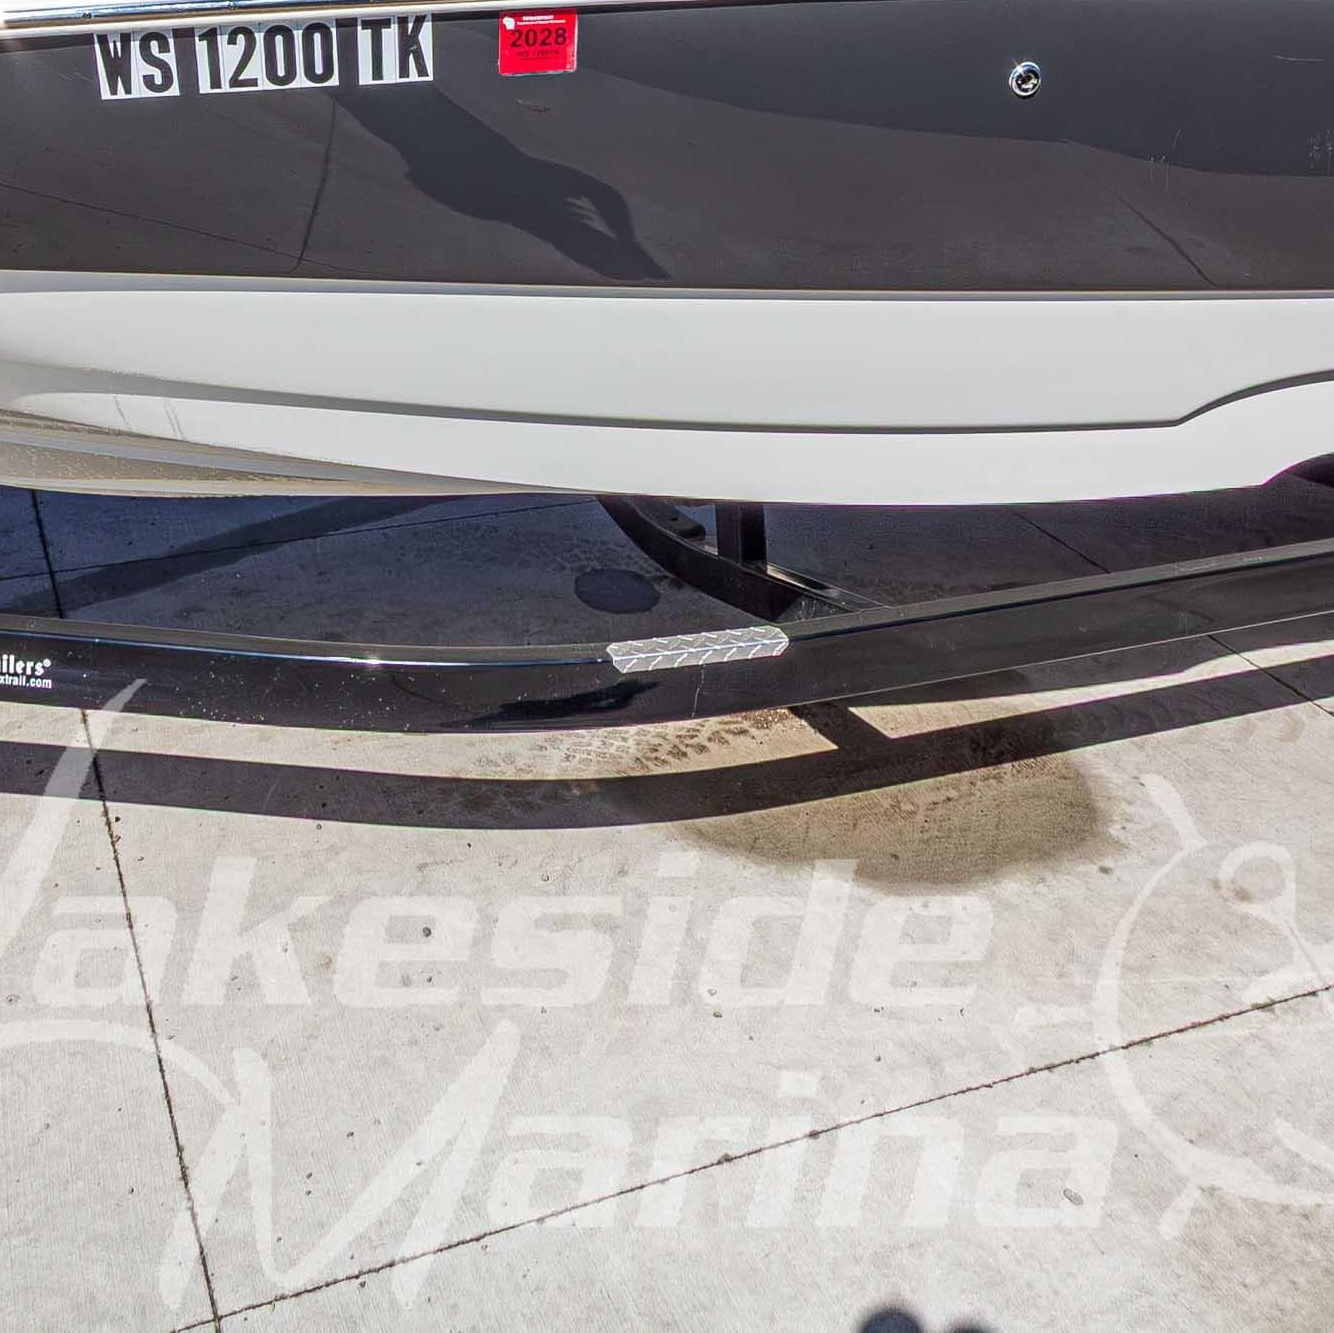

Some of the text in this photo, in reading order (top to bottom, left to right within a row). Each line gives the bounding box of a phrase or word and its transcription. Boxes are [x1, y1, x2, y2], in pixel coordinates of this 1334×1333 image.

[96, 13, 431, 97] WS 1200 TK
[510, 27, 567, 48] 2028
